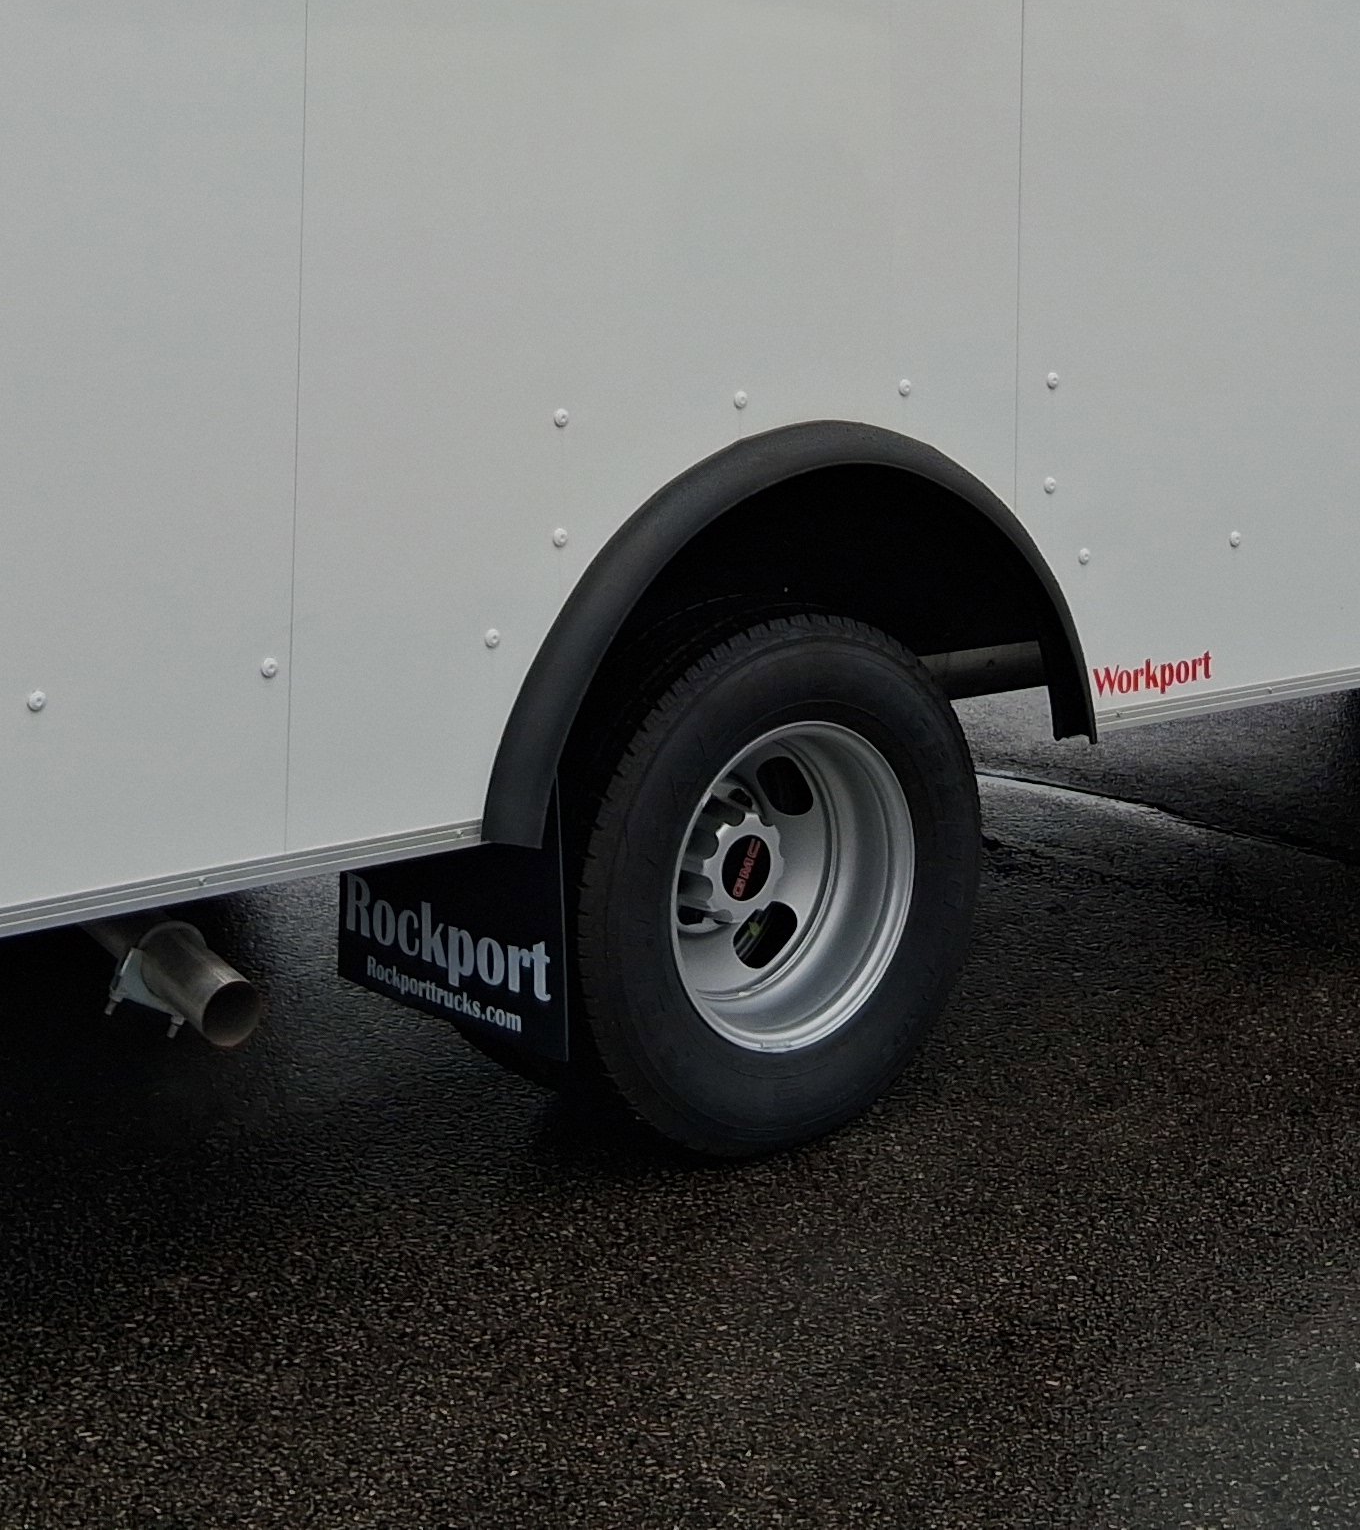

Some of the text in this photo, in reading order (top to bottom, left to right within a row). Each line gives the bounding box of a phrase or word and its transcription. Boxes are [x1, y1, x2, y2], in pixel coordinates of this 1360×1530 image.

[1092, 650, 1212, 698] Workport
[732, 838, 761, 898] GMC
[346, 872, 551, 1002] Rockport
[367, 955, 522, 1032] Rockporttrucks.com
